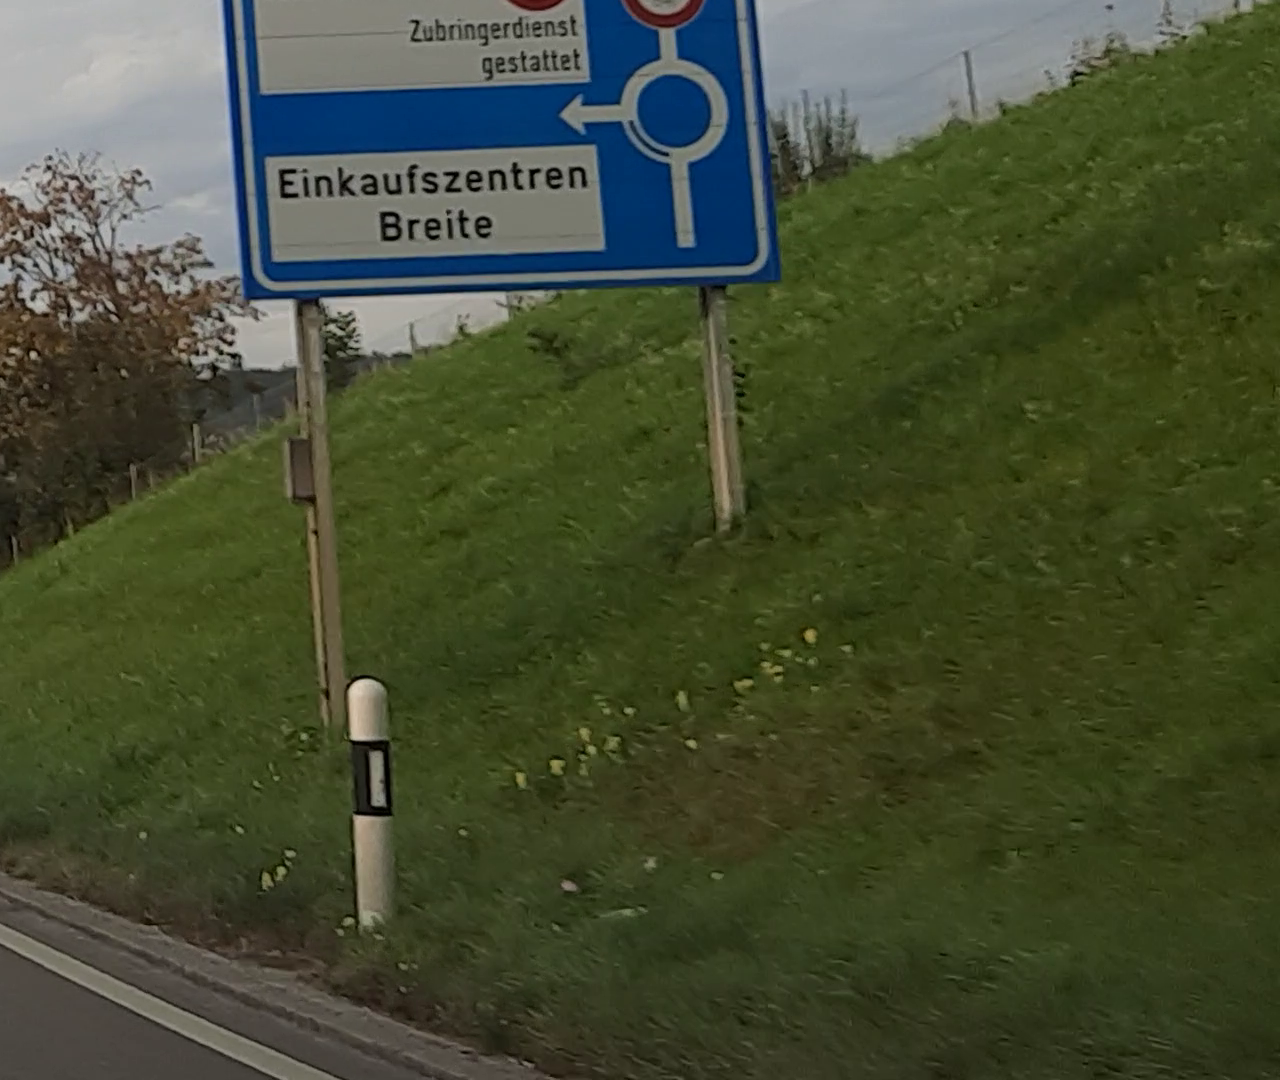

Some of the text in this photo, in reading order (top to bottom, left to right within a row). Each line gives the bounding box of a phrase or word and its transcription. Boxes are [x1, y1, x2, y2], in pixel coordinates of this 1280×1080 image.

[408, 14, 579, 46] Zubringerdienst
[481, 50, 582, 82] gestattet
[278, 162, 590, 200] Einkaufszentren
[378, 209, 494, 243] Breite
